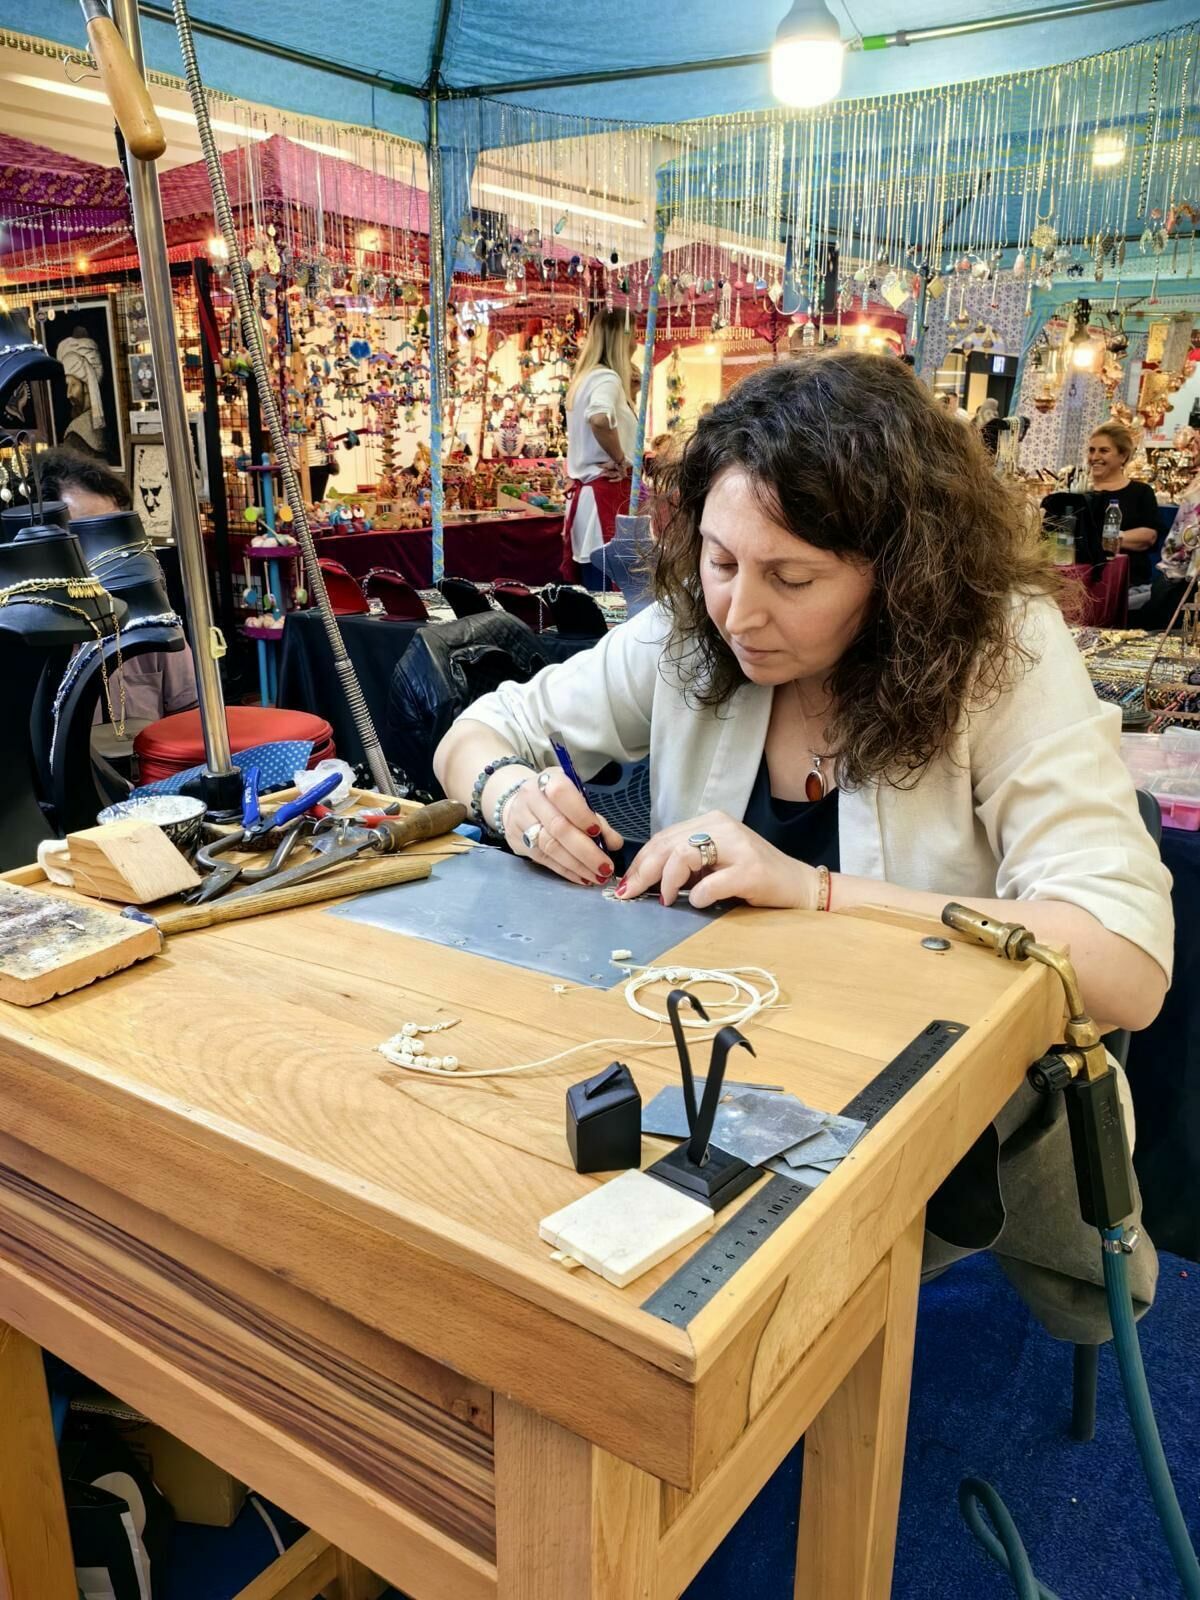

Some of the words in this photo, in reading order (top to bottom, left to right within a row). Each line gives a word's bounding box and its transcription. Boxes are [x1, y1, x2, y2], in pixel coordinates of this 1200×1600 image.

[661, 1316, 672, 1324] 1
[674, 1303, 686, 1311] 2
[687, 1289, 698, 1298] 3
[701, 1276, 711, 1285] 4
[712, 1264, 724, 1272] 5
[725, 1252, 736, 1260] 6
[735, 1240, 746, 1248] 7
[767, 1203, 784, 1215] 10
[779, 1195, 792, 1204] 11
[789, 1185, 802, 1194] 12
